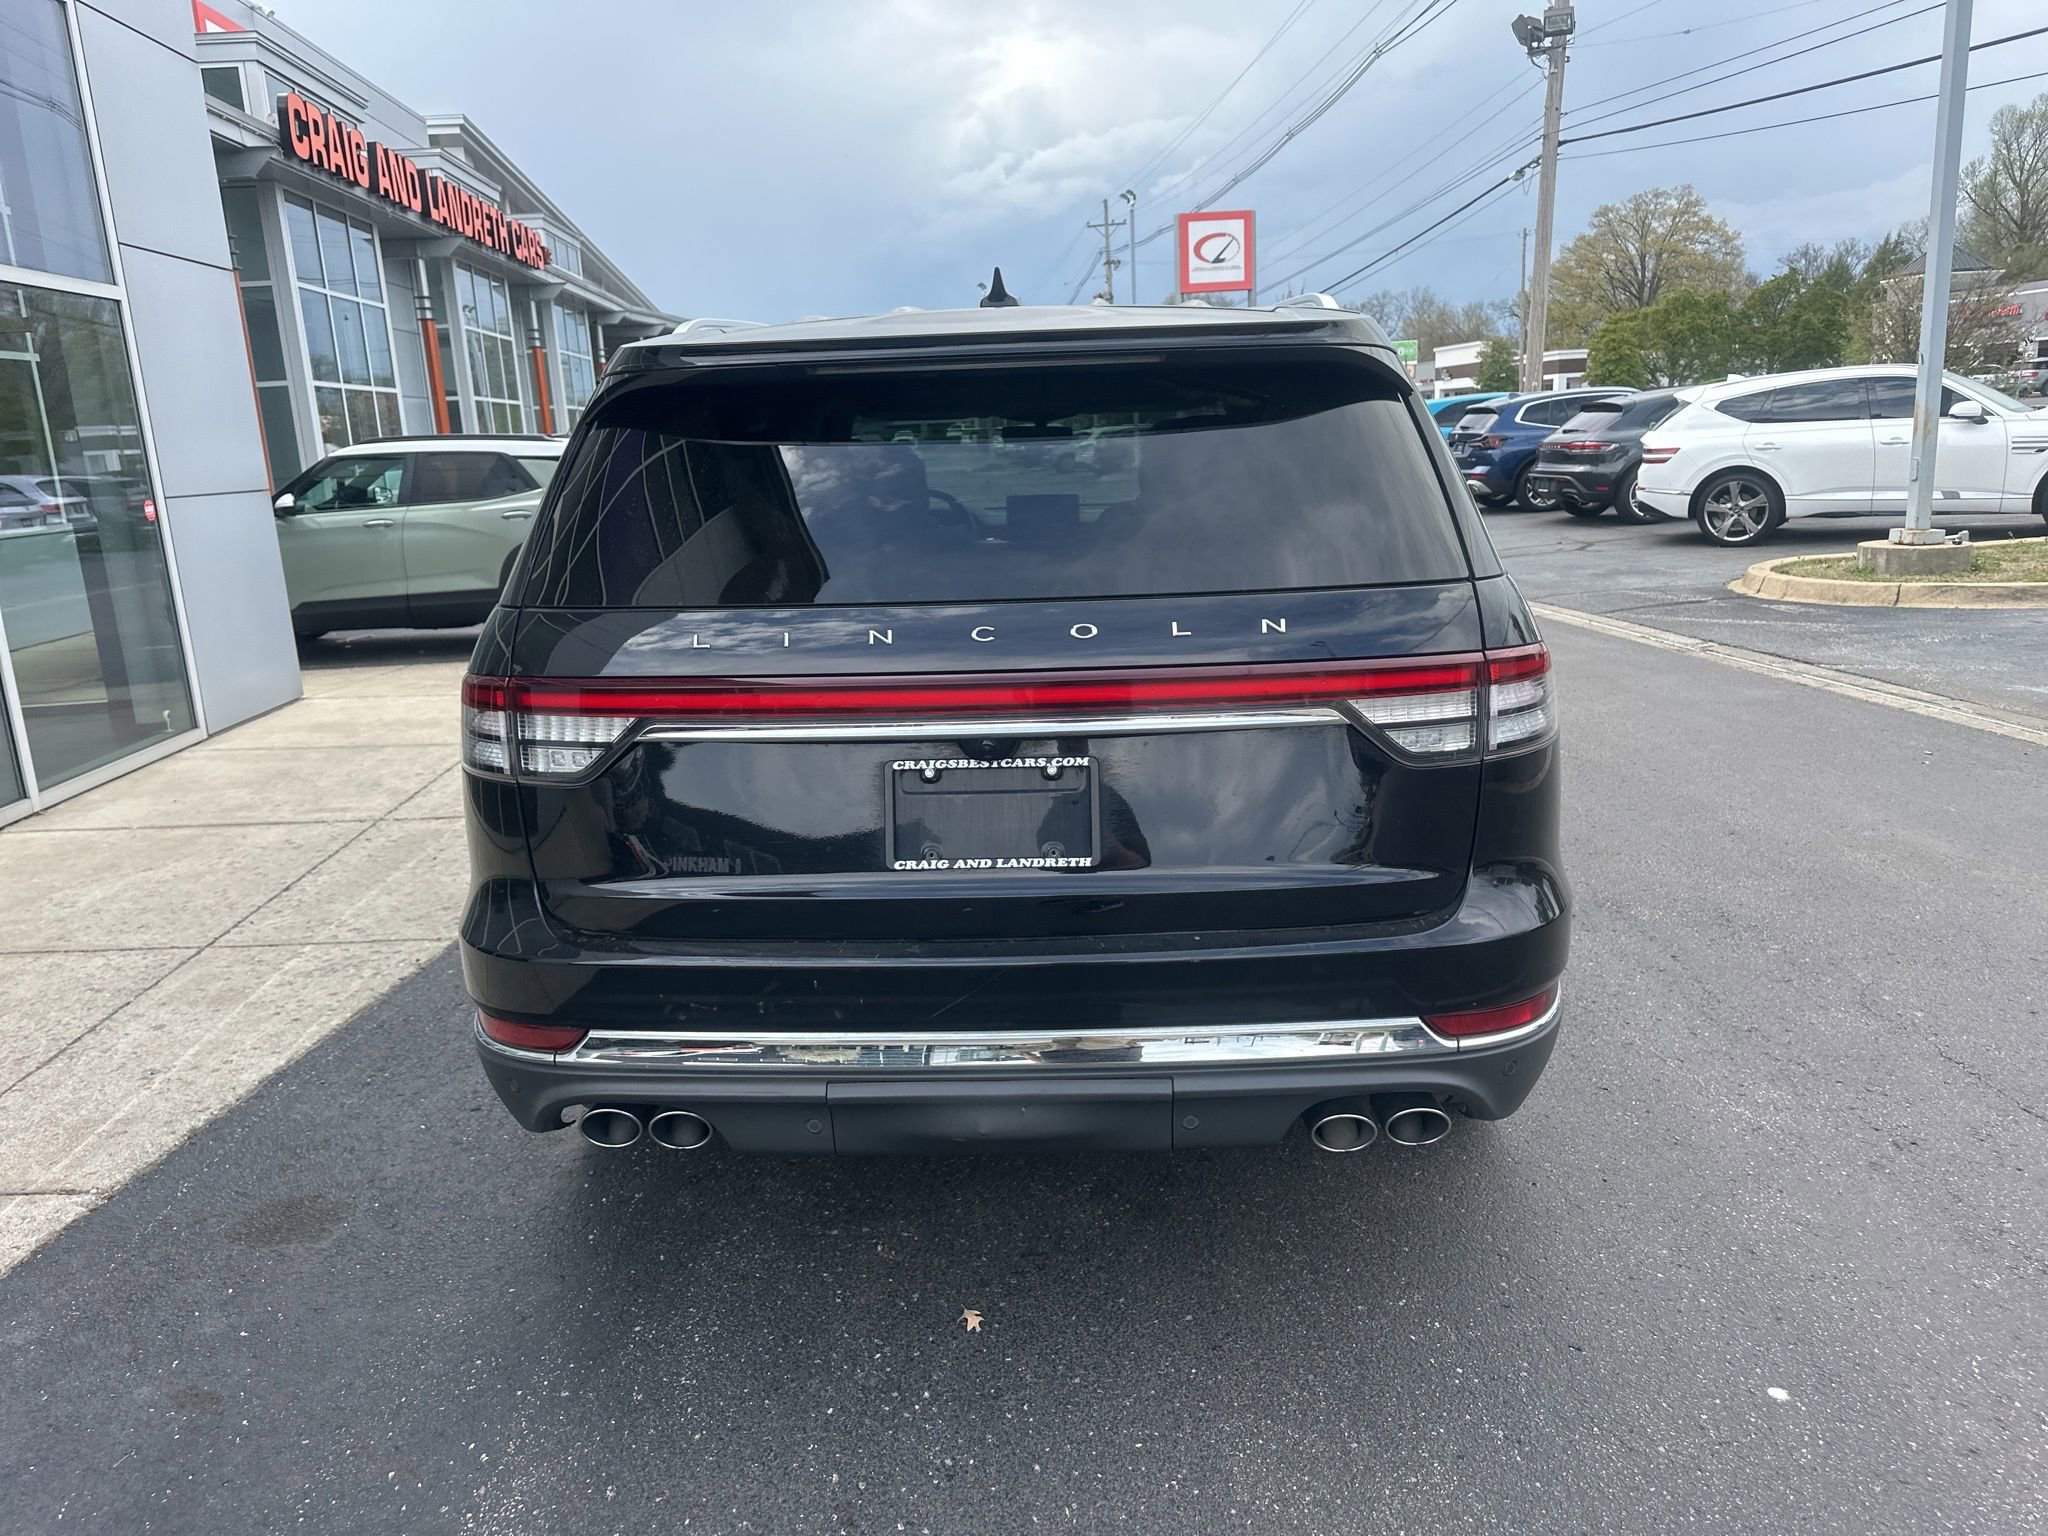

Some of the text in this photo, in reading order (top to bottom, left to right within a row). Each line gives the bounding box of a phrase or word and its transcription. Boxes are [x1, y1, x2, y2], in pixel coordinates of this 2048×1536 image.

[287, 92, 545, 271] CRAIG AND LANDRETH CARS
[692, 617, 1287, 649] LINCOLN
[892, 756, 1090, 770] CRAIGSBESTCARS.COM
[893, 857, 1093, 870] CRAIG AND LANDRETH
